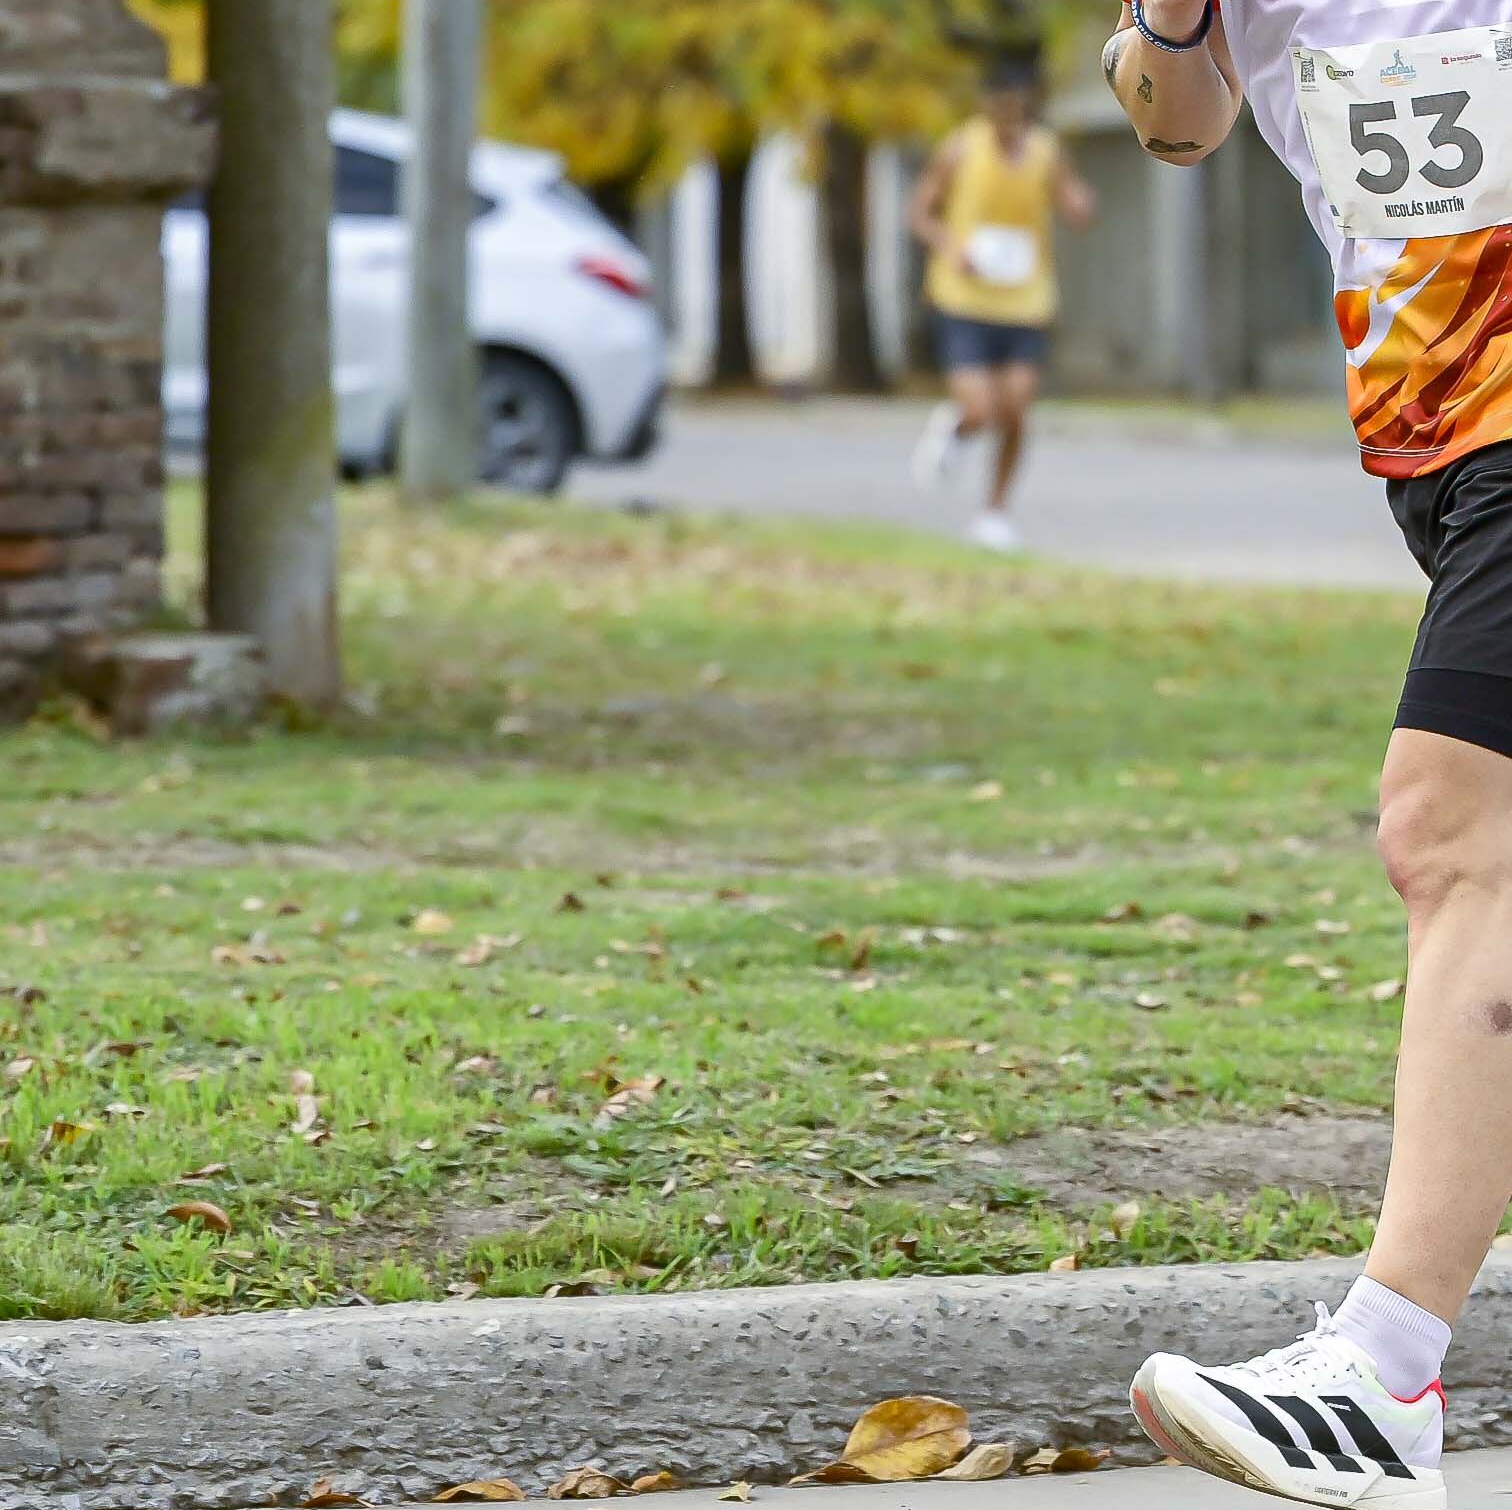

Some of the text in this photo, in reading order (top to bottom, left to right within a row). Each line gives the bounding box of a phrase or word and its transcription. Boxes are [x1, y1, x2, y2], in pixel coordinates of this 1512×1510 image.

[1349, 90, 1483, 194] 53
[1384, 195, 1465, 218] NICOLÁS MARTÍN
